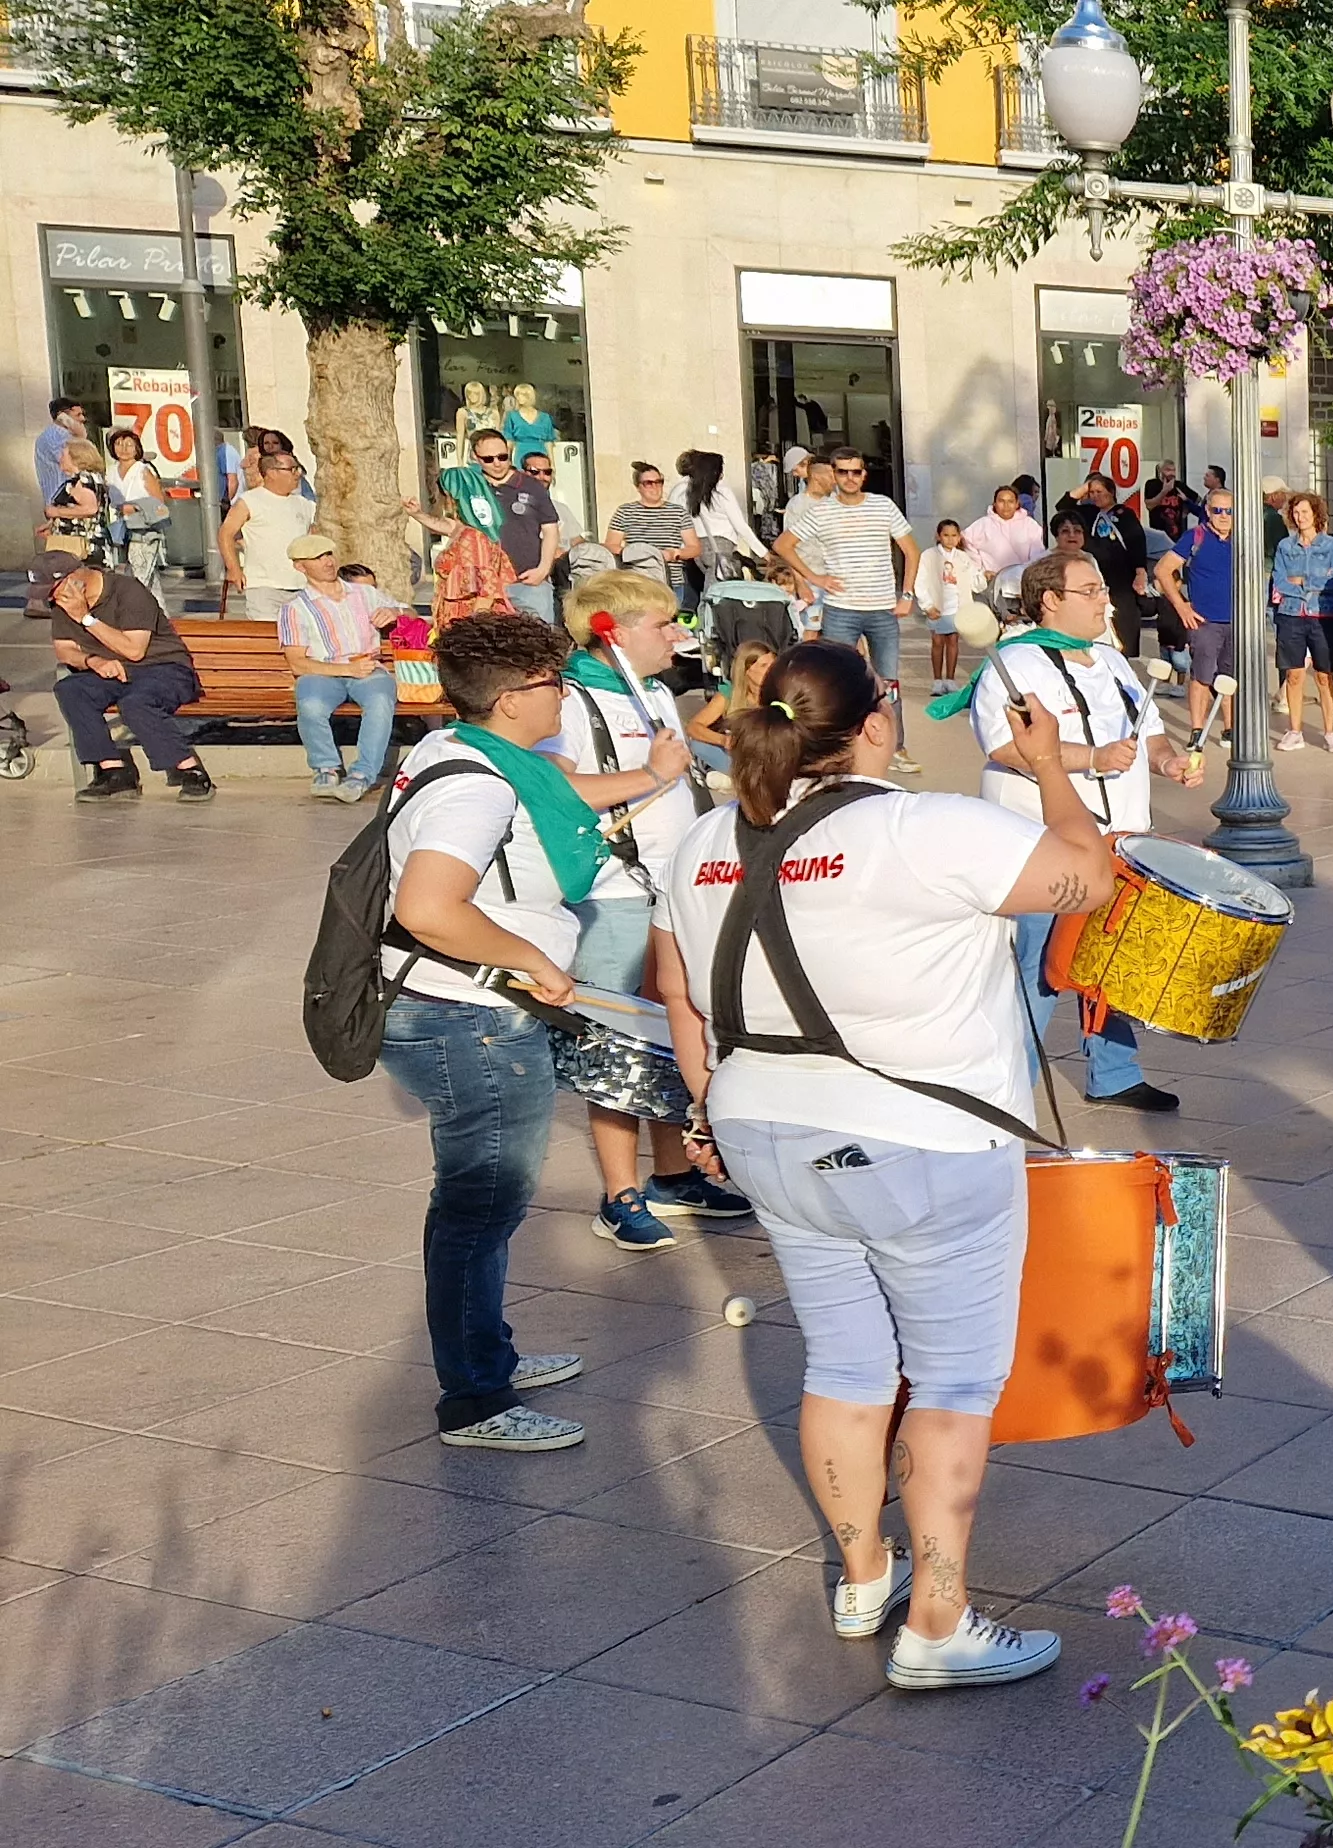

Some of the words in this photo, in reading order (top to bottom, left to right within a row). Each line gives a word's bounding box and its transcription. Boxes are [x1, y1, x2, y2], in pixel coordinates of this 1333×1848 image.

[56, 243, 132, 270] Pilar
[133, 378, 191, 396] Rebajas
[113, 402, 195, 463] 70
[1096, 415, 1138, 432] Rebajas
[1081, 436, 1139, 489] 70
